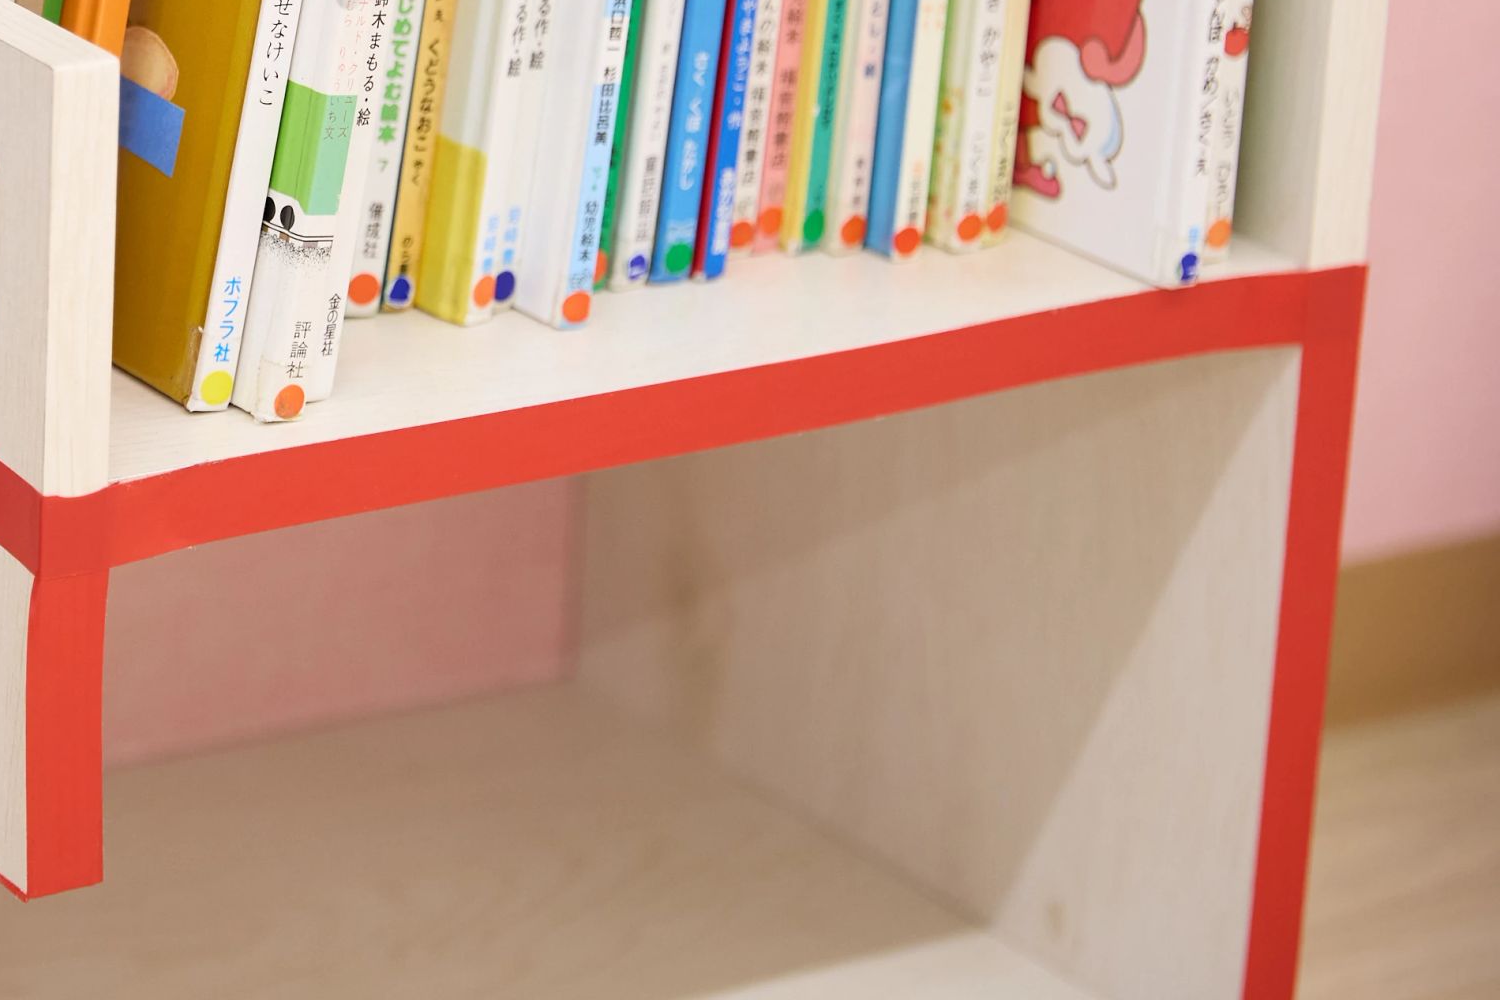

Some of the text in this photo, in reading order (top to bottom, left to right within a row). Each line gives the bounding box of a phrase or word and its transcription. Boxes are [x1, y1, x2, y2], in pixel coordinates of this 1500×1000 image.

[213, 276, 243, 364] ポプラ社
[287, 320, 312, 379] 評論社
[321, 293, 343, 357] 金の星社
